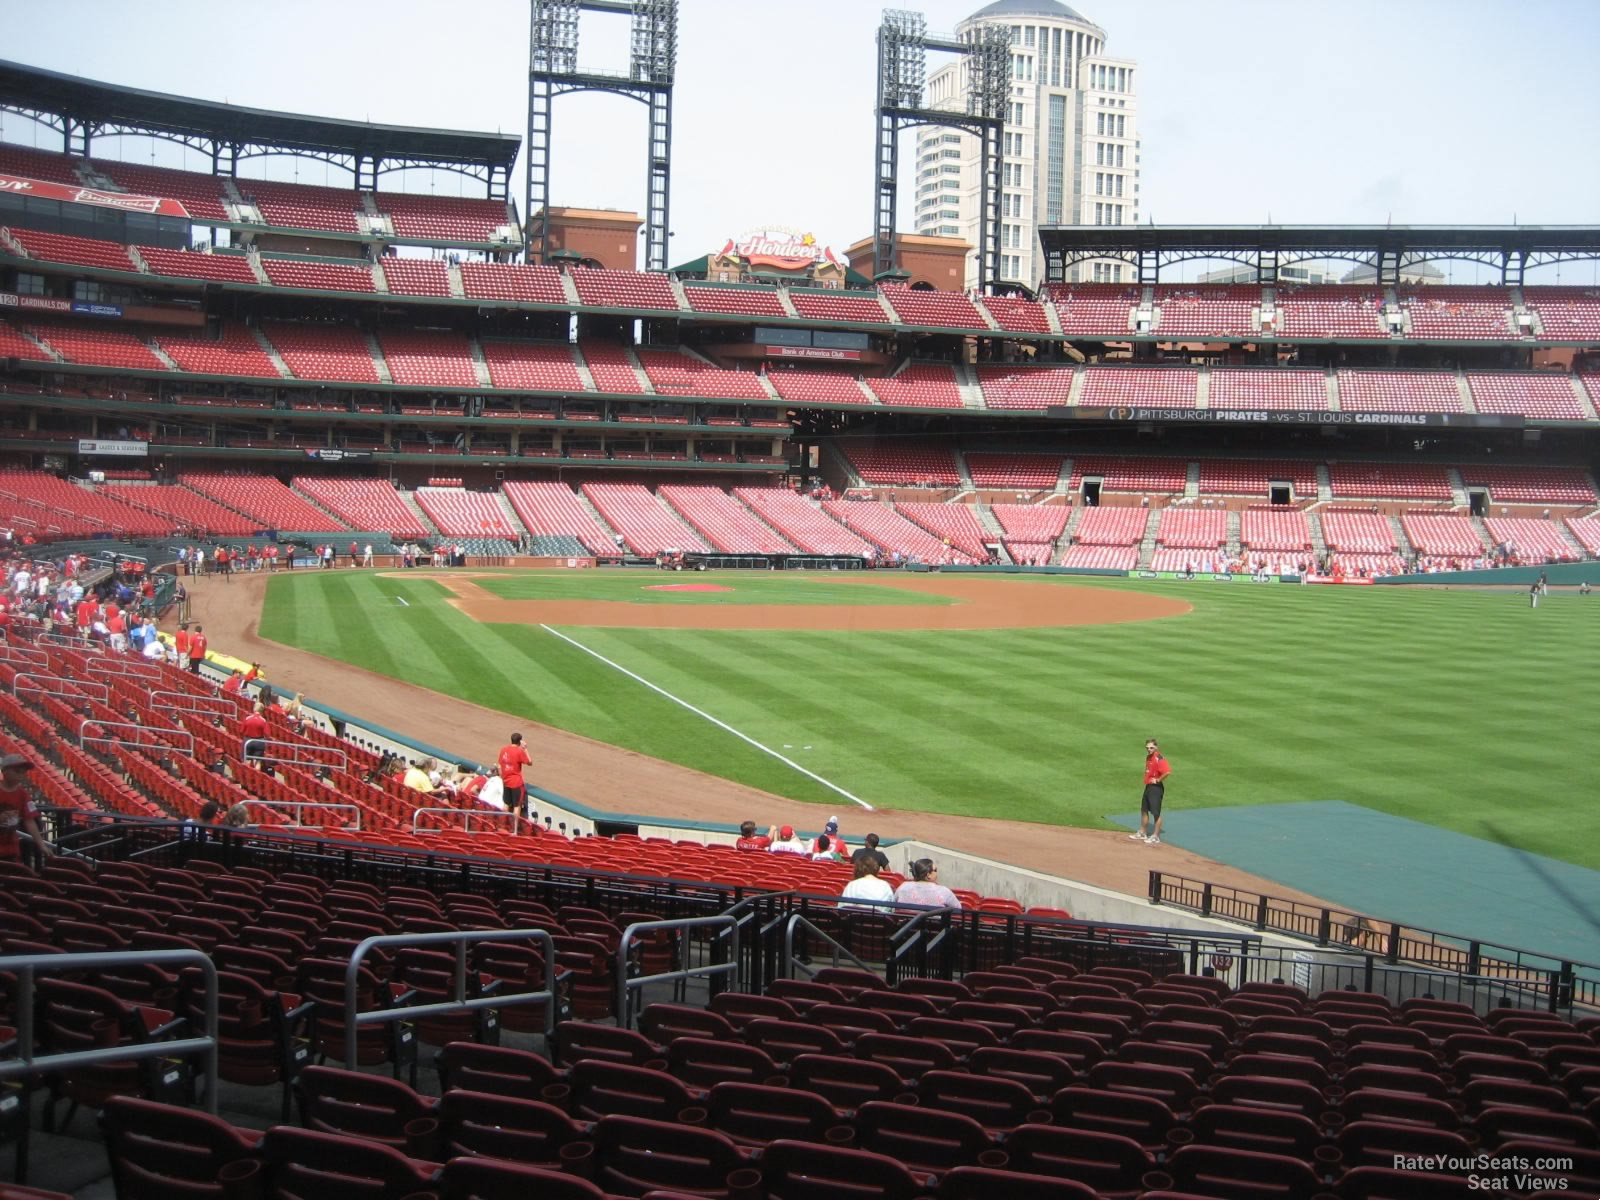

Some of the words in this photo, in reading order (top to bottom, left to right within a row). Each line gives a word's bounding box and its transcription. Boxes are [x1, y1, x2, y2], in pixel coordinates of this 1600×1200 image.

[20, 297, 71, 311] CARDINALS.COM
[806, 349, 830, 357] America
[831, 350, 845, 358] Club
[1139, 409, 1213, 420] PITTSBURGH
[1215, 411, 1268, 420] PIRATES
[1298, 412, 1314, 422] ST.
[1318, 413, 1352, 423] LOUIS
[1355, 413, 1426, 424] CARDINALS
[1214, 955, 1231, 967] 132
